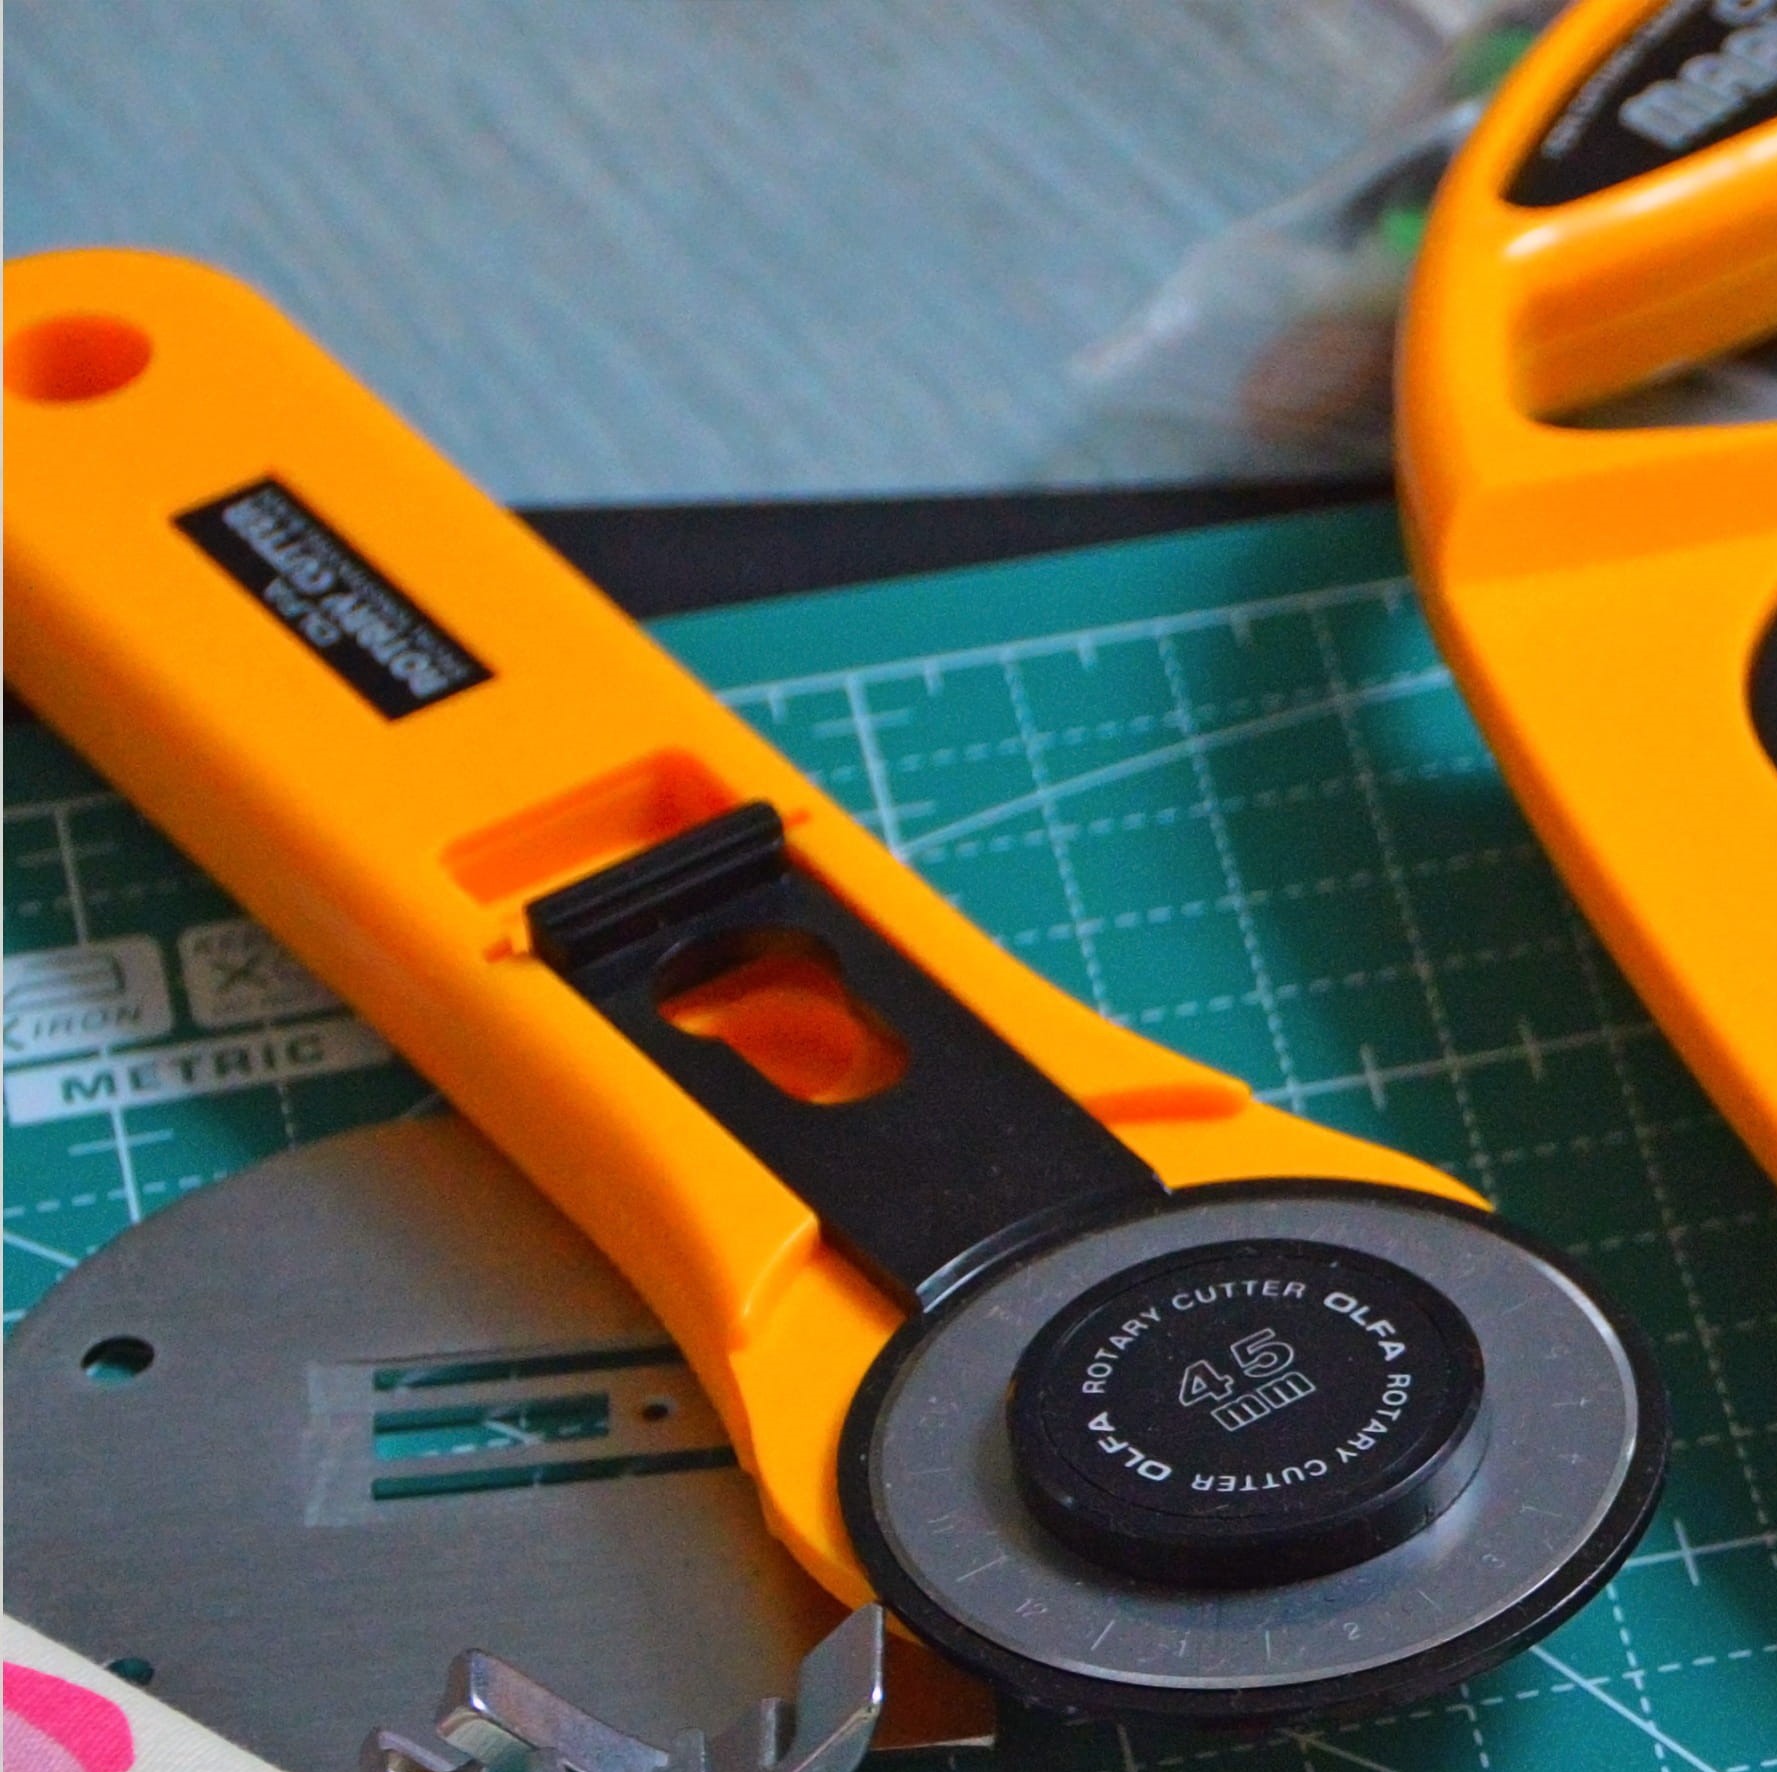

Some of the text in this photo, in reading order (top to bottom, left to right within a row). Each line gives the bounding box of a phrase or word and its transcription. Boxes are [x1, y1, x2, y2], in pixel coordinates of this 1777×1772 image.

[60, 1032, 326, 1104] METRIC
[1083, 1280, 1411, 1492] OLFA ROTARY CUTTER OLFA ROTARY CUTTER
[1179, 1328, 1295, 1407] 45
[1210, 1371, 1316, 1432] mm
